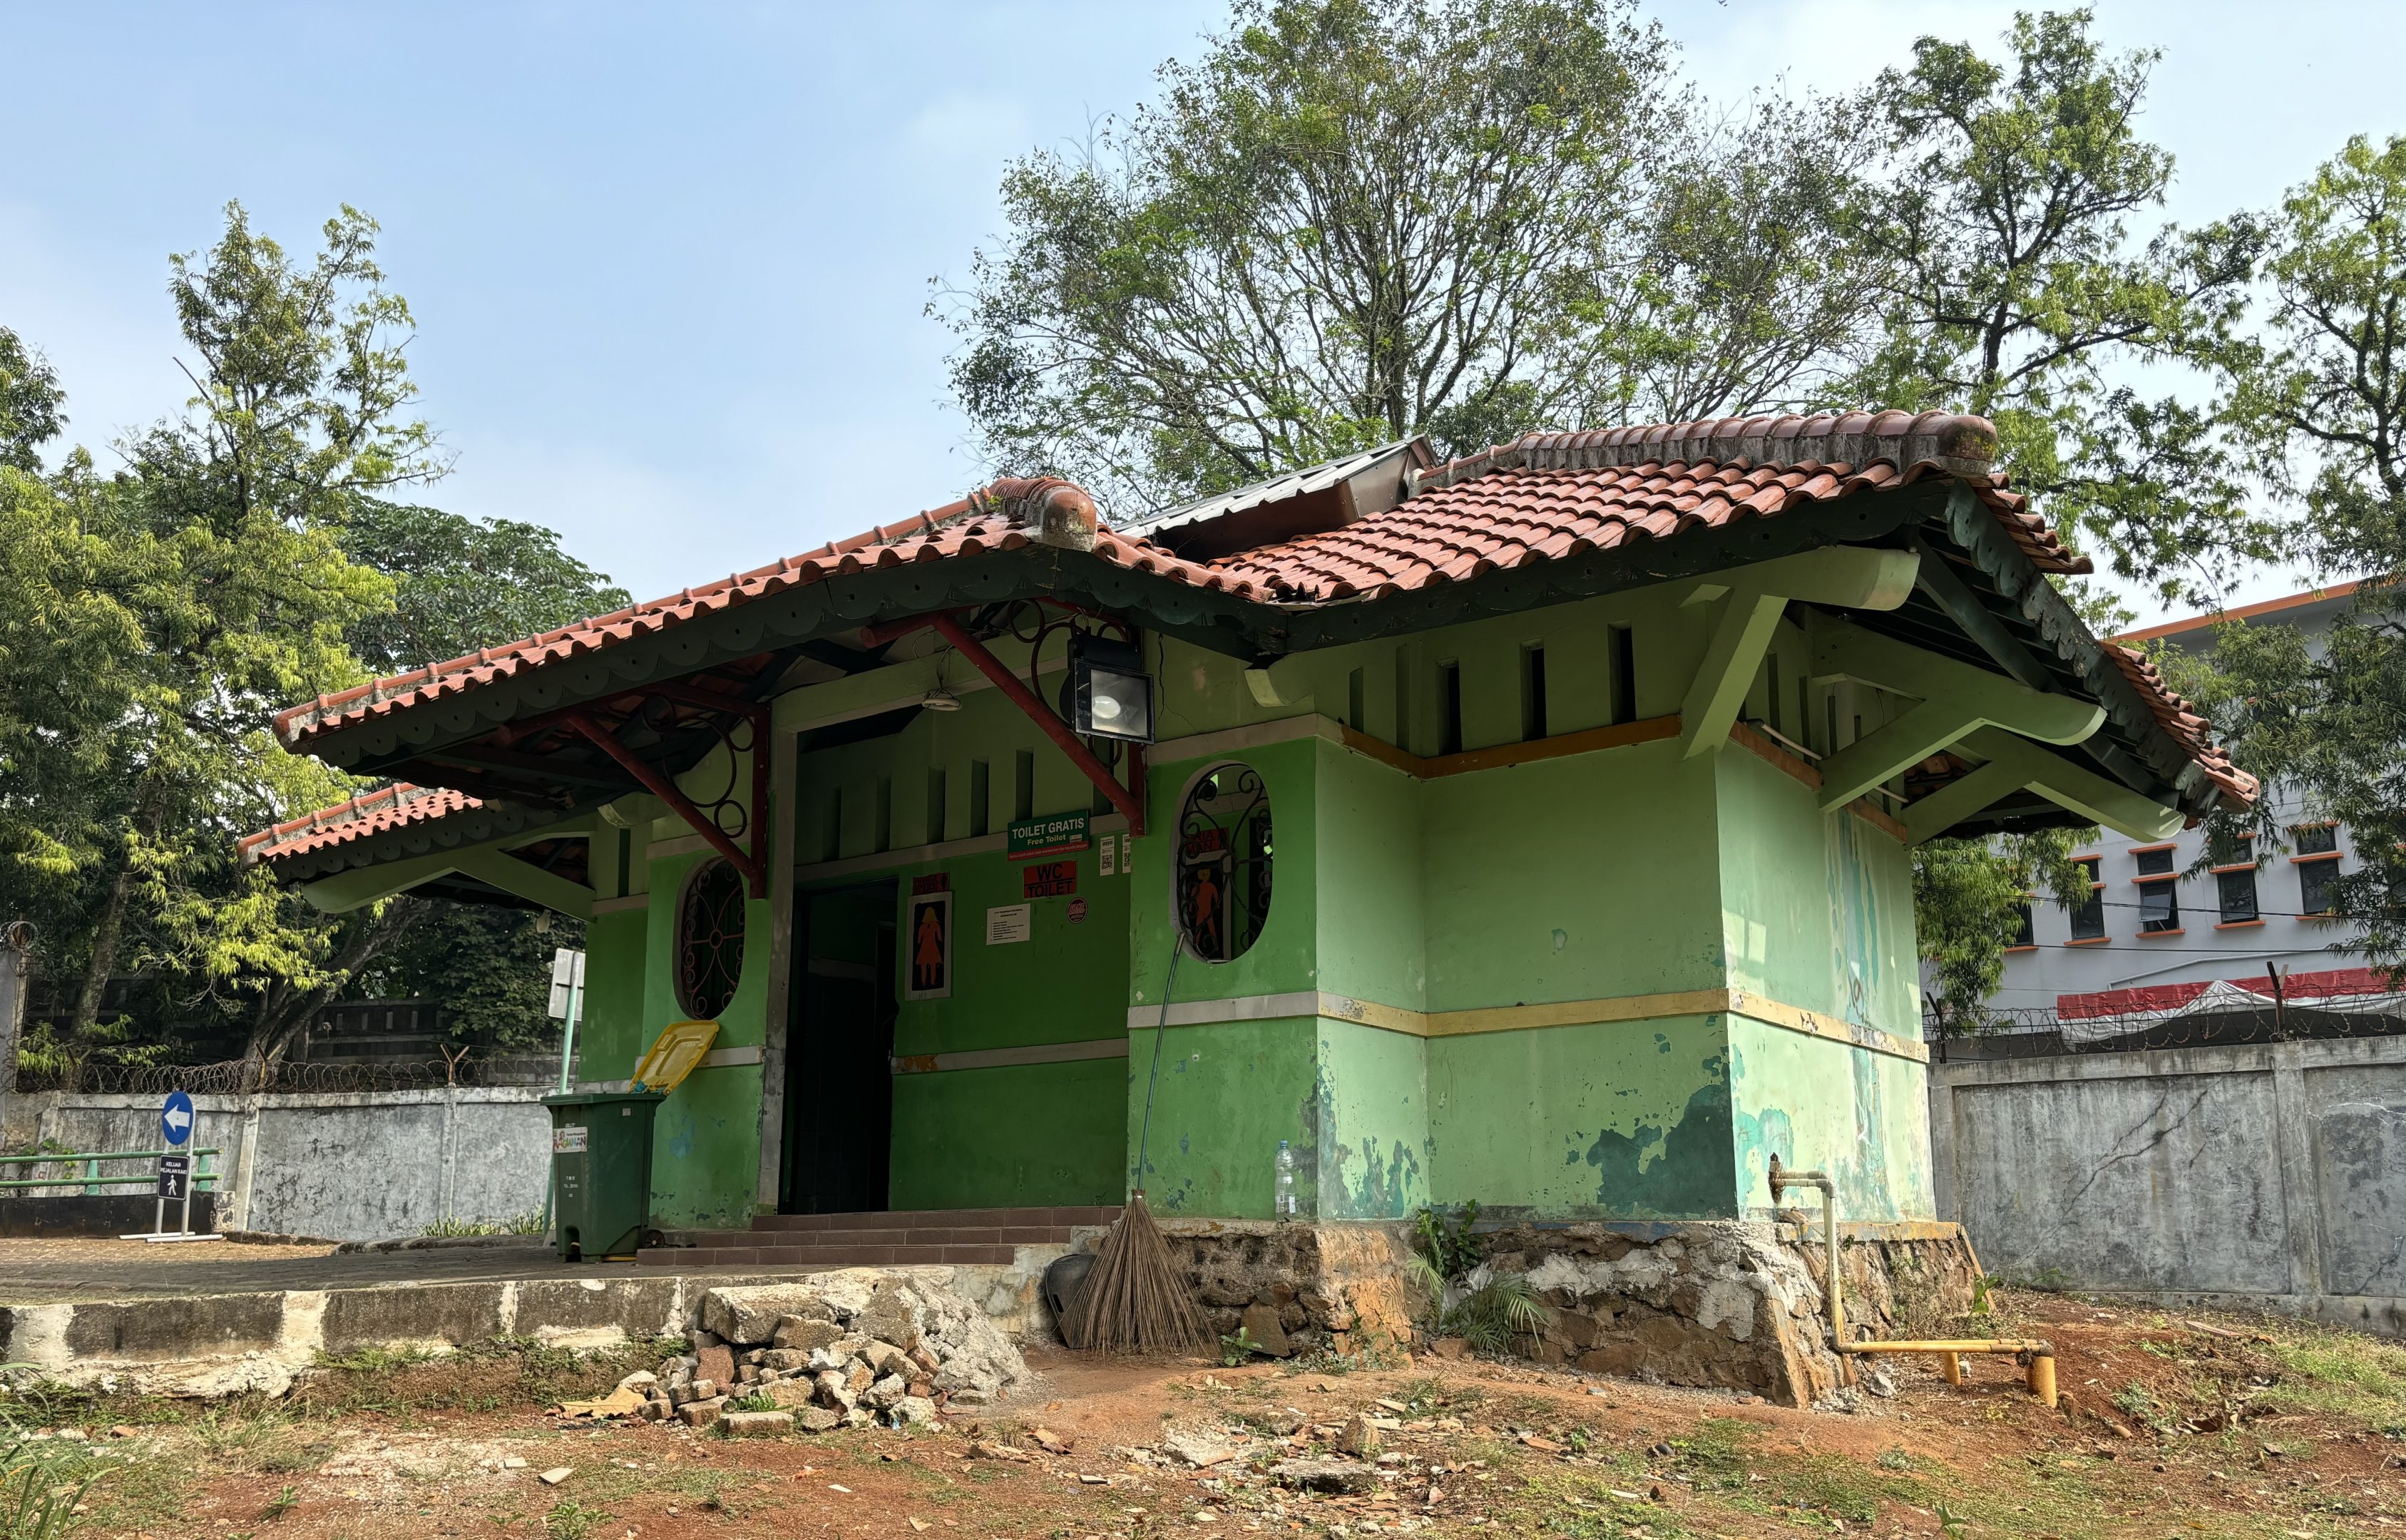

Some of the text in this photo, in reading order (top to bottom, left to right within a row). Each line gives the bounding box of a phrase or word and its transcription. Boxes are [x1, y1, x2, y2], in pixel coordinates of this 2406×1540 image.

[1012, 818, 1085, 839] TOILET GRATIS
[1045, 834, 1066, 843] Toilet
[1038, 863, 1063, 881] WC
[1028, 881, 1073, 898] TOILET
